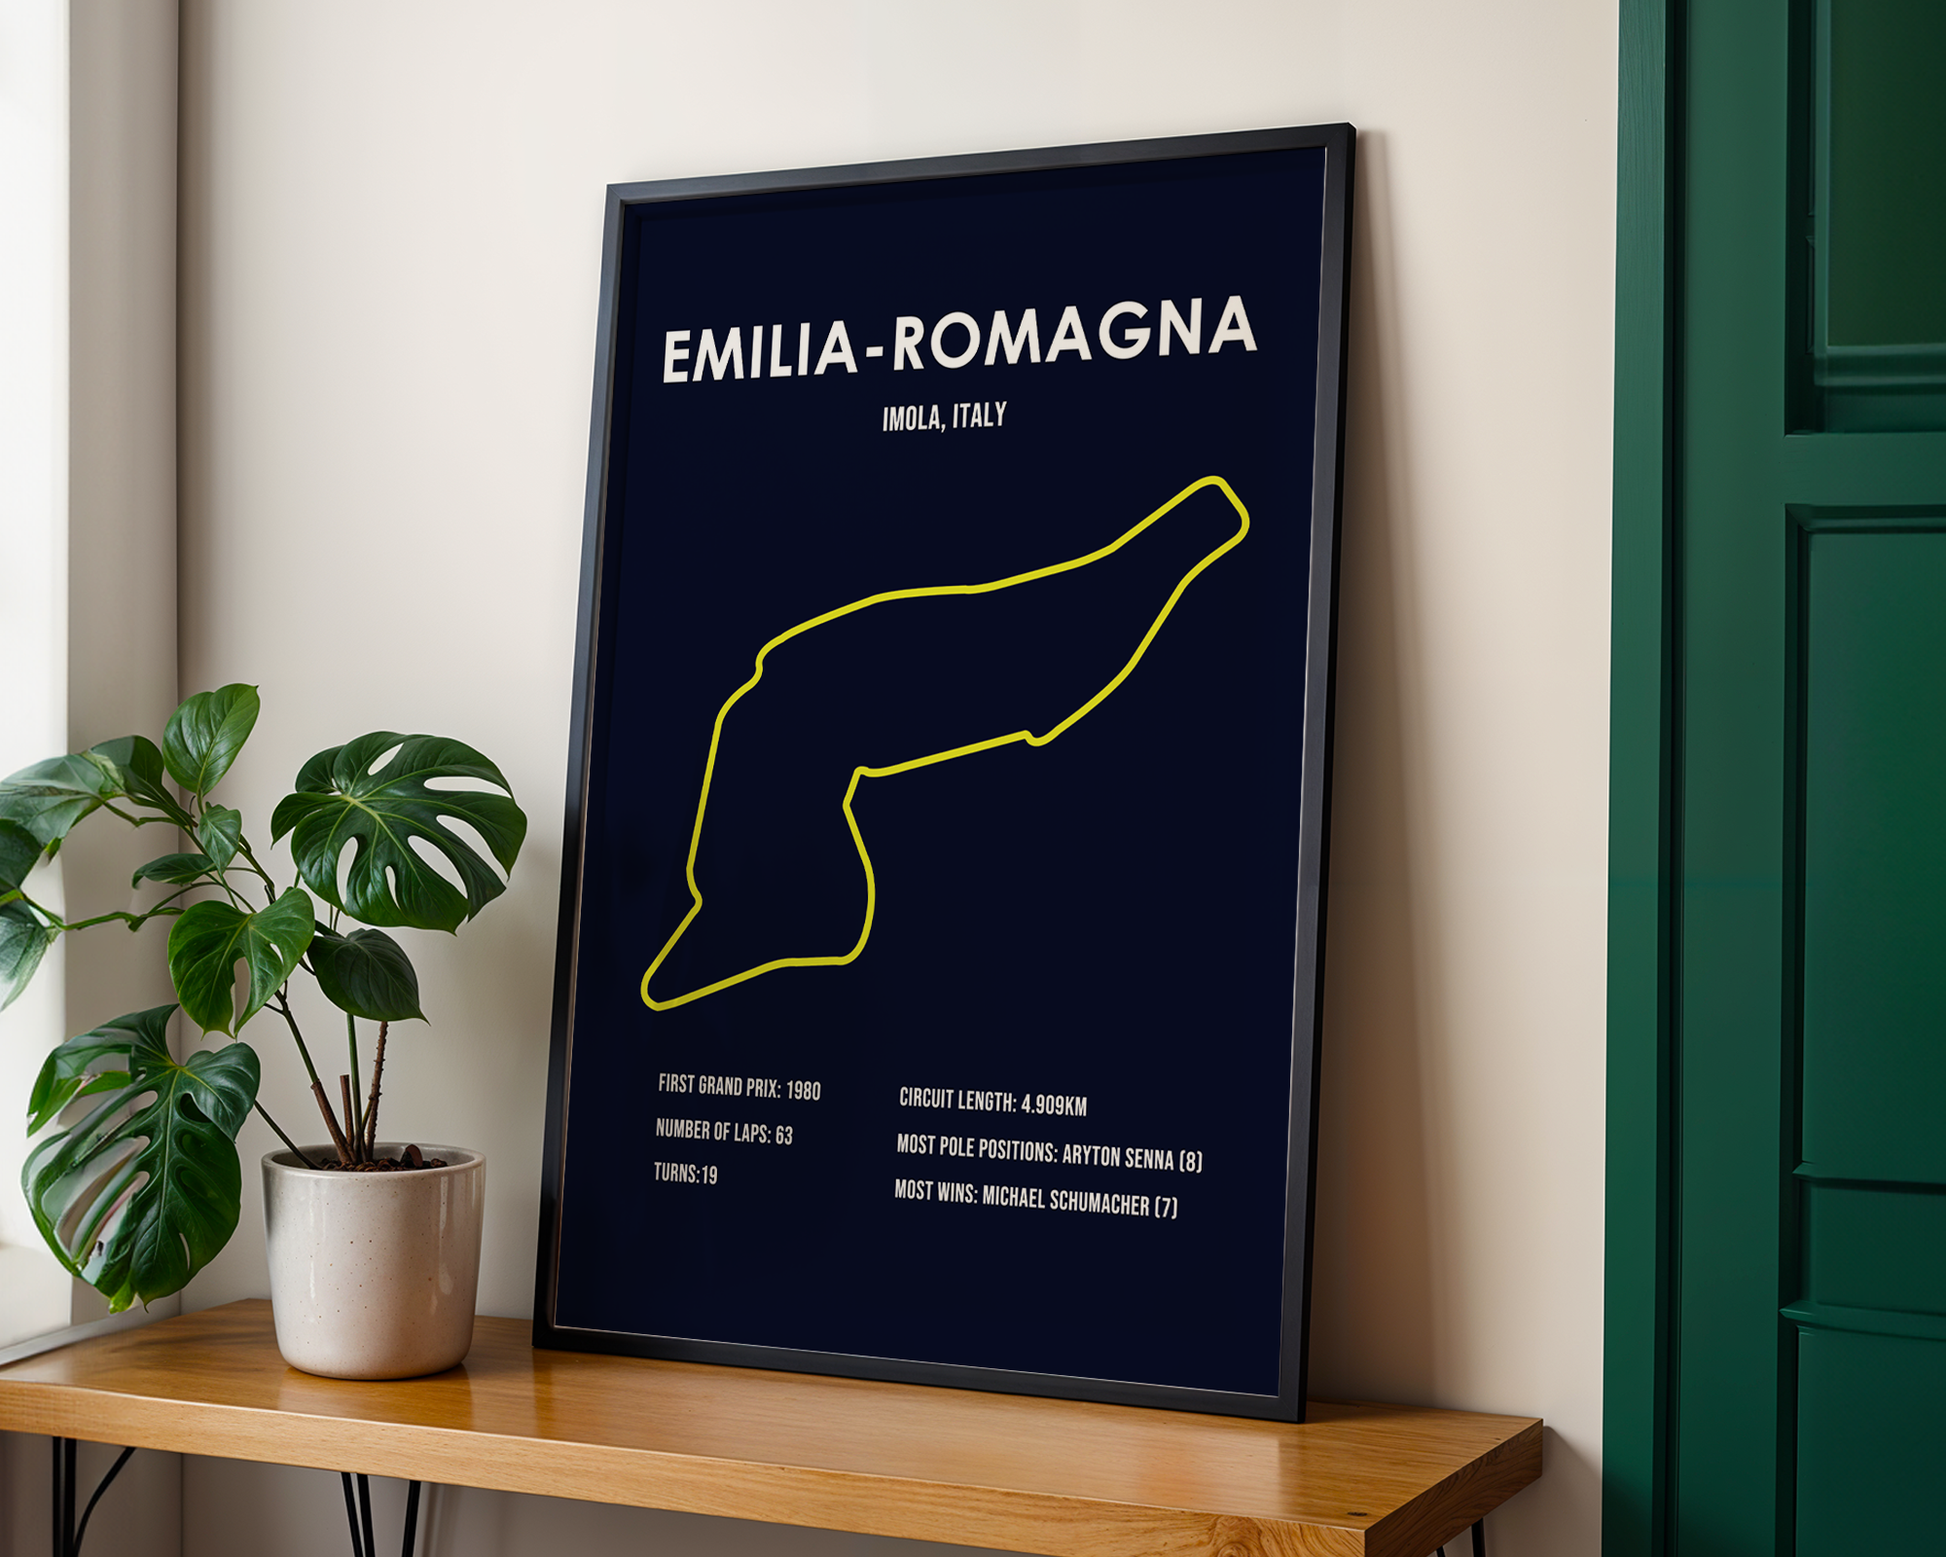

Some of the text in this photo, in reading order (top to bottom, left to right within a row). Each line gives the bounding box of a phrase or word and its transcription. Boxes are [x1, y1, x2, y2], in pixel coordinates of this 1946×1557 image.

[663, 296, 1257, 383] EMILIA-ROMAGNA
[883, 401, 1008, 433] IMOLA, ITALY
[659, 1073, 821, 1101] FIRST GRAND PRIX: 1980
[900, 1086, 1088, 1117] CIRCUIT LENGTH: 4.909KM
[656, 1118, 793, 1146] NUMBER OF LAPS: 63
[897, 1133, 1203, 1174] MOST POLE POSITIONS: ARYTON SENNA (8)
[895, 1179, 1178, 1219] MOST WINS: MICHAEL SCHUMACHER (7)
